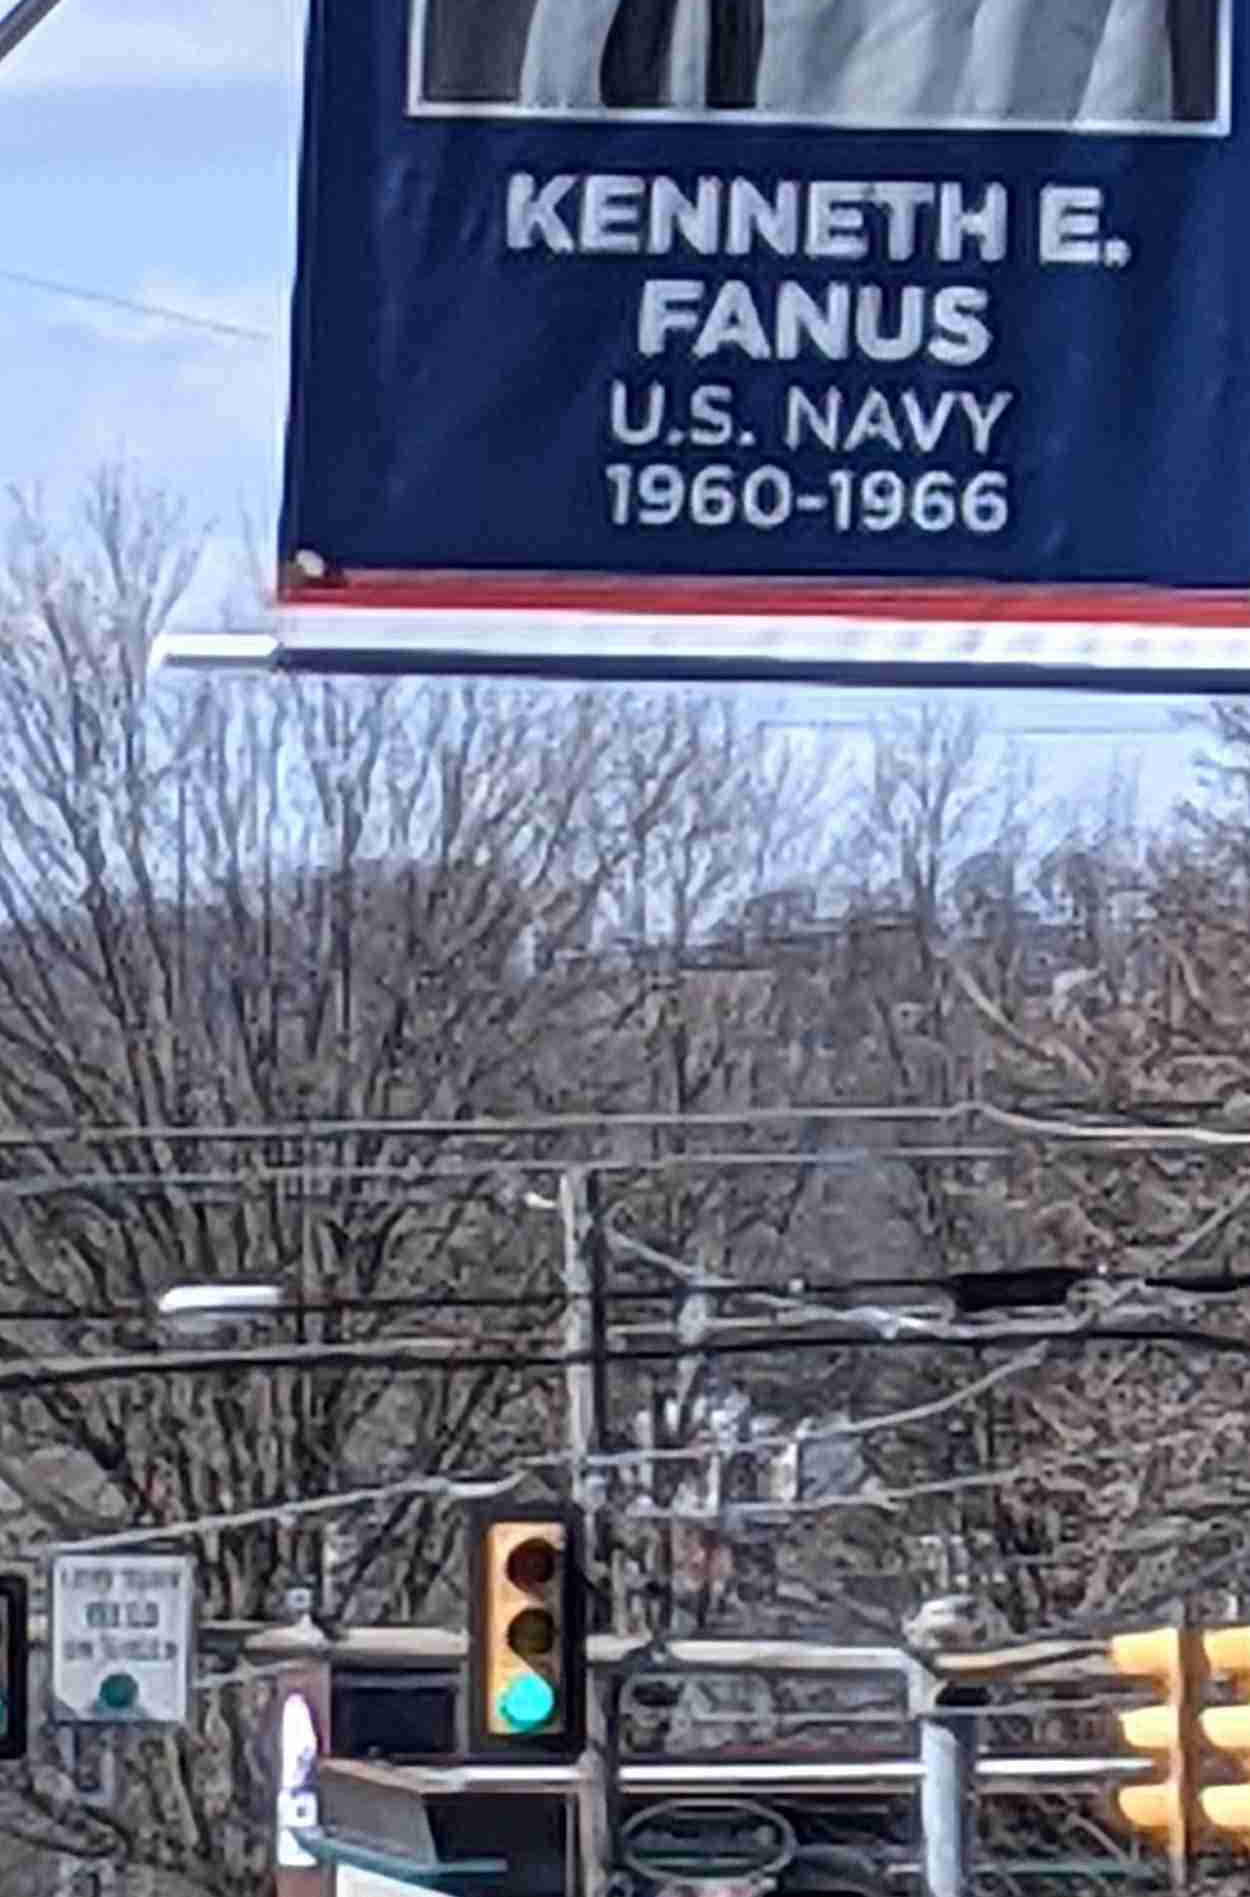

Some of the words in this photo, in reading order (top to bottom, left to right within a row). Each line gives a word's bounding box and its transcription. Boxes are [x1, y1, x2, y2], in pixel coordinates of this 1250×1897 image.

[507, 173, 1007, 261] KENNETH
[1038, 186, 1131, 267] E.
[638, 279, 991, 365] FANUS
[611, 380, 755, 446] U.S.
[786, 385, 1012, 454] NAVY
[605, 464, 1009, 533] 1960-1966
